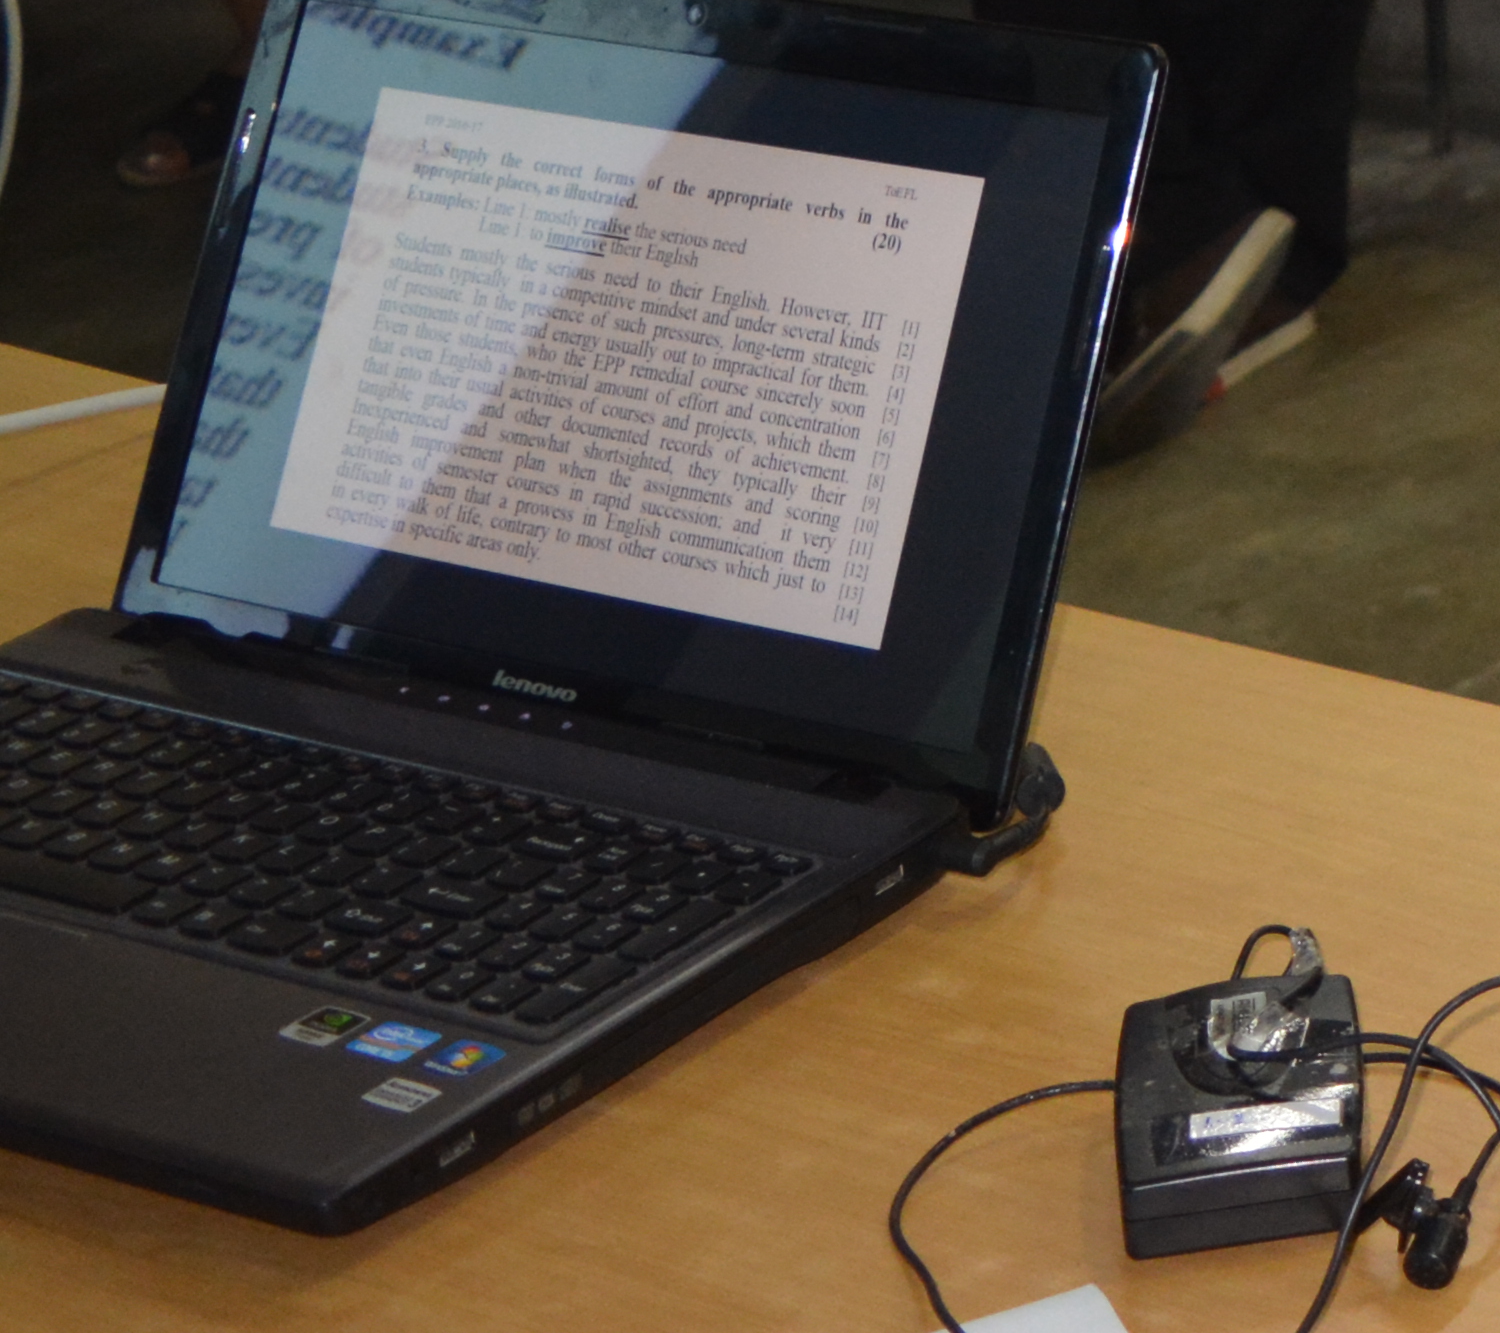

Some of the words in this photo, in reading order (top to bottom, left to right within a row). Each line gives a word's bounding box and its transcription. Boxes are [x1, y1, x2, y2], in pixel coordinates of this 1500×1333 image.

[411, 162, 494, 186] appropriate
[494, 172, 541, 196] places,
[544, 183, 561, 197] as
[562, 181, 638, 209] illustrated.
[416, 137, 429, 155] 3.
[439, 141, 489, 169] Supply
[499, 151, 523, 169] the
[531, 160, 584, 179] correct
[592, 164, 635, 187] forms
[645, 174, 664, 191] of
[671, 177, 696, 196] the
[706, 187, 793, 212] appropriate
[804, 201, 846, 220] verbs
[856, 205, 873, 224] in
[883, 210, 909, 230] the
[545, 226, 608, 252] improve
[609, 237, 642, 258] their
[645, 242, 700, 268] English
[583, 214, 631, 235] realise
[634, 220, 656, 239] the
[659, 226, 709, 248] serious
[712, 235, 748, 254] need
[870, 230, 903, 255] (20)
[550, 285, 635, 311] competitive
[639, 296, 698, 321] mindset
[701, 307, 731, 327] and
[734, 313, 777, 335] under
[781, 323, 835, 344] several
[839, 328, 880, 352] kinds
[895, 338, 915, 362] [2]
[590, 309, 610, 328] of
[612, 315, 647, 334] such
[651, 324, 723, 351] pressures,
[731, 332, 805, 362] long-term
[812, 349, 875, 377] strategic
[890, 360, 910, 383] [3]
[603, 270, 639, 289] need
[645, 276, 661, 293] to
[668, 278, 703, 300] their
[711, 284, 769, 312] English.
[780, 296, 850, 328] However,
[861, 309, 887, 331] IIT
[900, 317, 920, 340] [1]
[512, 365, 589, 390] non-trivial
[594, 379, 649, 401] amount
[654, 387, 674, 405] of
[677, 390, 719, 414] effort
[725, 400, 754, 420] and
[758, 409, 860, 439] concentration
[876, 425, 896, 449] [6]
[524, 342, 557, 363] who
[563, 347, 586, 368] the
[592, 352, 625, 375] EPP
[629, 364, 694, 387] remedial
[699, 376, 748, 397] course
[755, 382, 822, 415] sincerely
[829, 399, 865, 417] soon
[881, 403, 900, 427] [5]
[551, 328, 600, 353] energy
[604, 337, 657, 363] usually
[661, 347, 687, 363] out
[691, 349, 707, 367] to
[712, 351, 795, 382] impractical
[800, 366, 823, 387] for
[827, 371, 868, 395] them.
[886, 382, 905, 405] [4]
[509, 384, 573, 410] activities
[578, 395, 598, 414] of
[600, 403, 656, 425] courses
[661, 411, 690, 431] and
[693, 419, 756, 446] projects,
[765, 429, 812, 453] which
[817, 437, 856, 461] them
[871, 447, 891, 471] [7]
[513, 406, 552, 428] other
[560, 412, 650, 446] documented
[659, 436, 714, 458] records
[724, 444, 744, 463] of
[751, 450, 848, 483] achievement.
[865, 469, 886, 493] [8]
[498, 428, 570, 453] somewhat
[582, 440, 673, 476] shortsighted,
[687, 459, 720, 487] they
[732, 468, 797, 501] typically
[810, 482, 846, 505] their
[861, 491, 881, 515] [9]
[513, 449, 546, 472] plan
[557, 458, 597, 481] when
[608, 466, 631, 487] the
[643, 477, 733, 507] assignments
[744, 494, 774, 514] and
[784, 504, 840, 532] scoring
[852, 512, 879, 538] [10]
[433, 501, 453, 520] of
[456, 503, 482, 529] life,
[489, 515, 550, 544] contrary
[555, 525, 571, 543] to
[575, 532, 613, 551] most
[617, 537, 656, 560] other
[661, 549, 718, 572] courses
[723, 558, 771, 583] which
[775, 566, 804, 591] just
[810, 575, 826, 594] to
[837, 579, 864, 605] [13]
[498, 495, 508, 508] a
[513, 498, 574, 521] prowess
[582, 506, 597, 526] in
[604, 510, 662, 538] English
[668, 528, 784, 562] communication
[792, 547, 831, 571] them
[842, 557, 869, 582] [12]
[505, 474, 560, 496] courses
[569, 481, 584, 501] in
[592, 489, 632, 513] rapid
[640, 500, 723, 530] succession;
[732, 515, 761, 535] and
[780, 521, 792, 541] it
[801, 530, 836, 554] very
[847, 535, 874, 560] [11]
[407, 521, 463, 544] specific
[465, 533, 503, 552] areas
[505, 539, 540, 564] only.
[832, 601, 860, 627] [14]
[492, 669, 578, 702] lenovo
